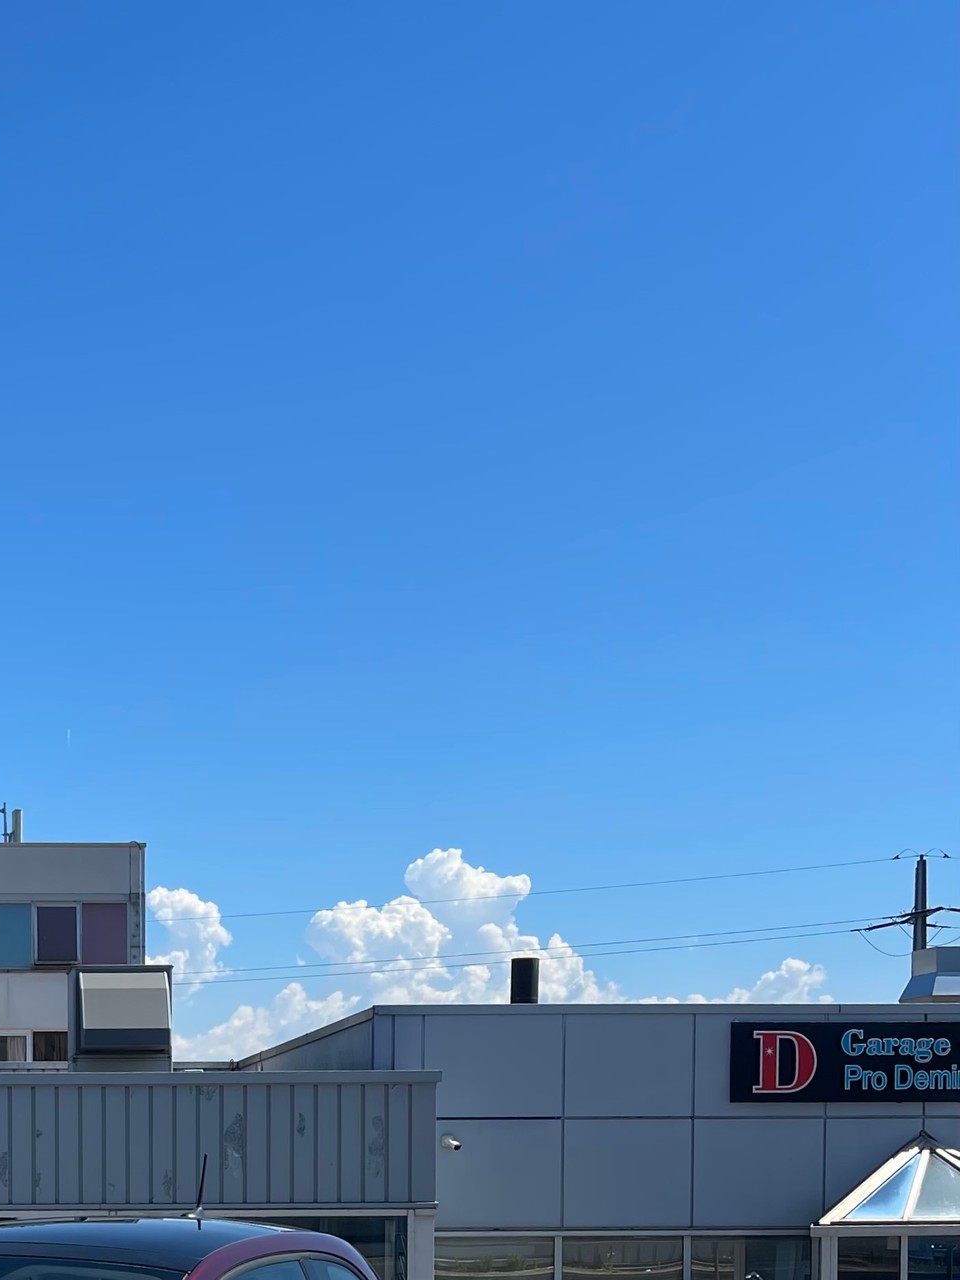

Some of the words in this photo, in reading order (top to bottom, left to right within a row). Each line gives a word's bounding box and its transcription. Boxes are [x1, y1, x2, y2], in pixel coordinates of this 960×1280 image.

[752, 1031, 818, 1094] D
[841, 1029, 951, 1063] Garage
[844, 1065, 887, 1091] Pro
[894, 1064, 960, 1090] Demi
